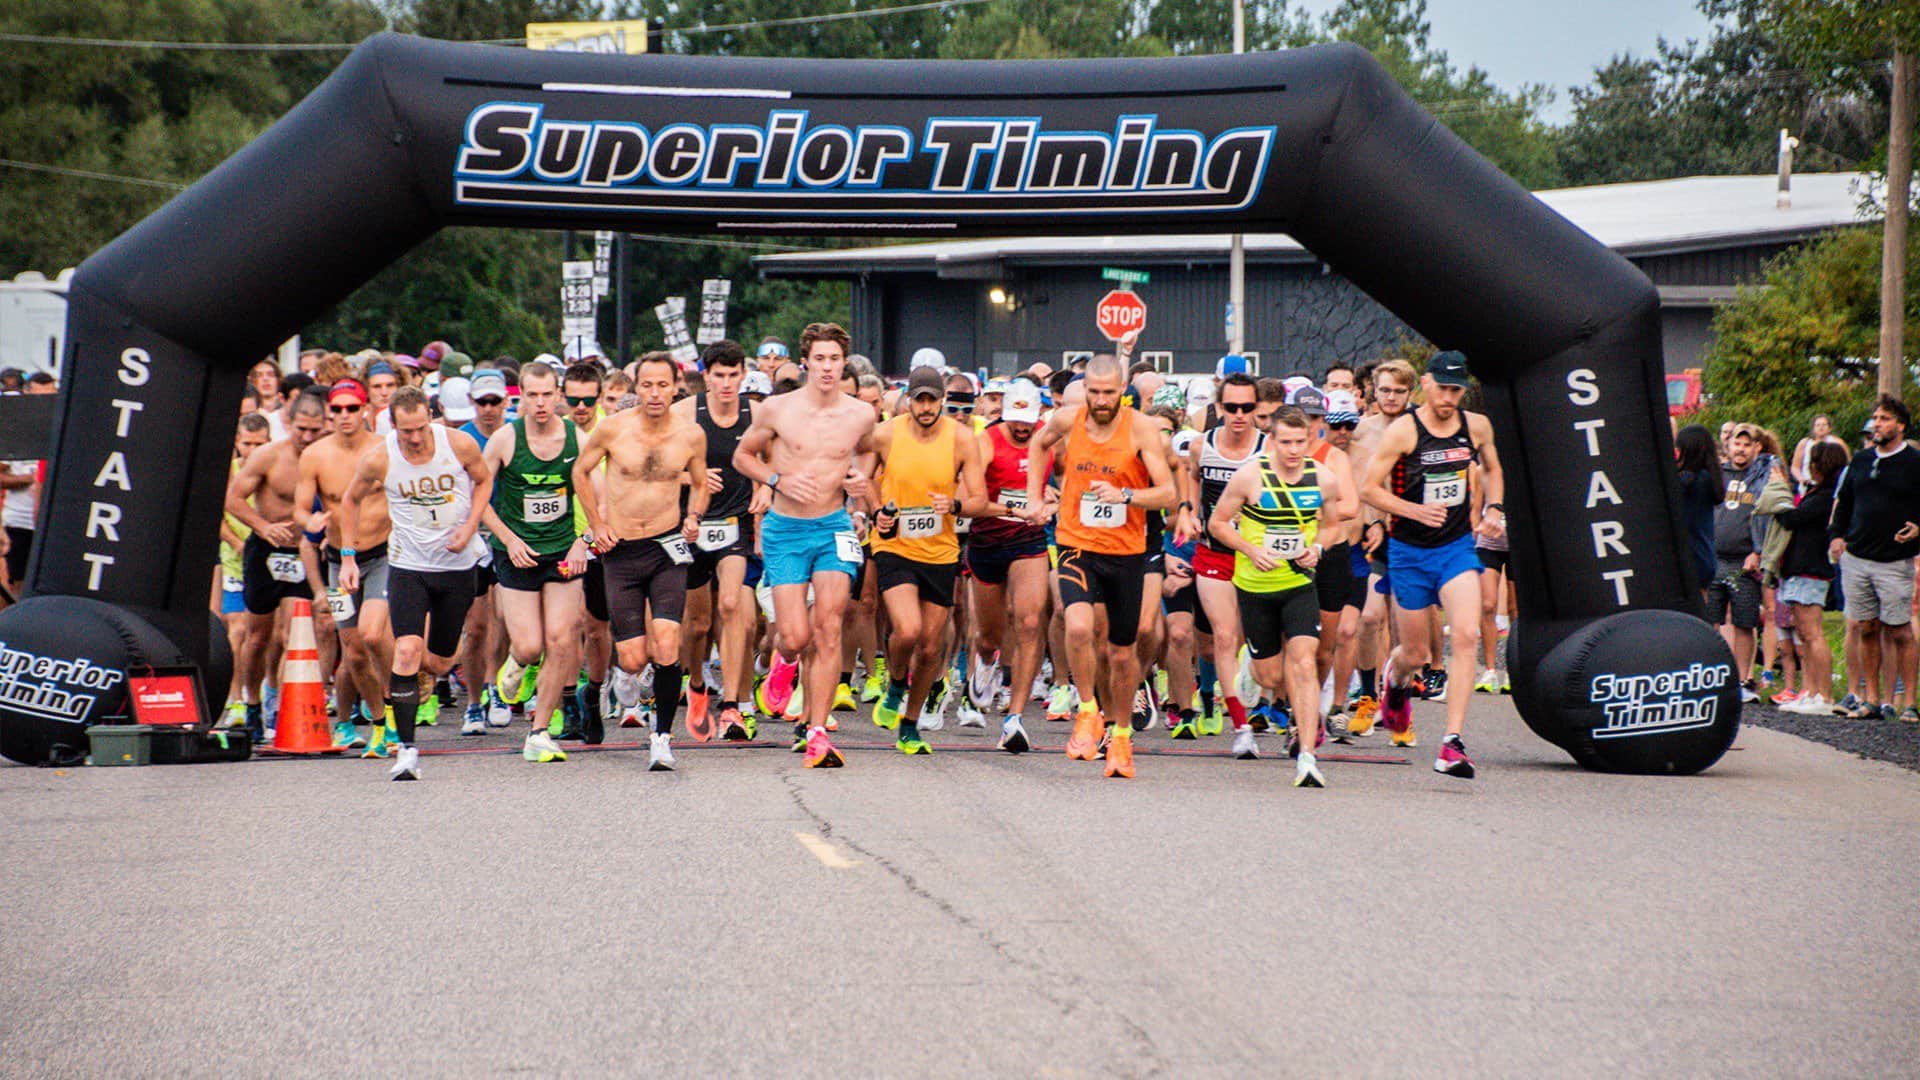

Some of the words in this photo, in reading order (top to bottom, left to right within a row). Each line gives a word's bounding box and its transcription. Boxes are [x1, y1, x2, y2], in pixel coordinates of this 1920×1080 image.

[453, 101, 913, 187] Superior
[920, 113, 1278, 212] Timing
[1101, 305, 1142, 326] STOP
[83, 347, 151, 592] START
[1433, 484, 1459, 499] 138
[1566, 368, 1634, 606] START
[429, 509, 437, 521] 1
[532, 501, 560, 515] 386
[1094, 505, 1112, 519] 26
[907, 518, 935, 531] 560
[707, 530, 725, 543] 60
[1271, 538, 1299, 552] 457
[0, 642, 124, 691] uperior
[1591, 662, 1731, 702] Superior
[0, 671, 97, 724] iming
[1603, 695, 1719, 729] Timing
